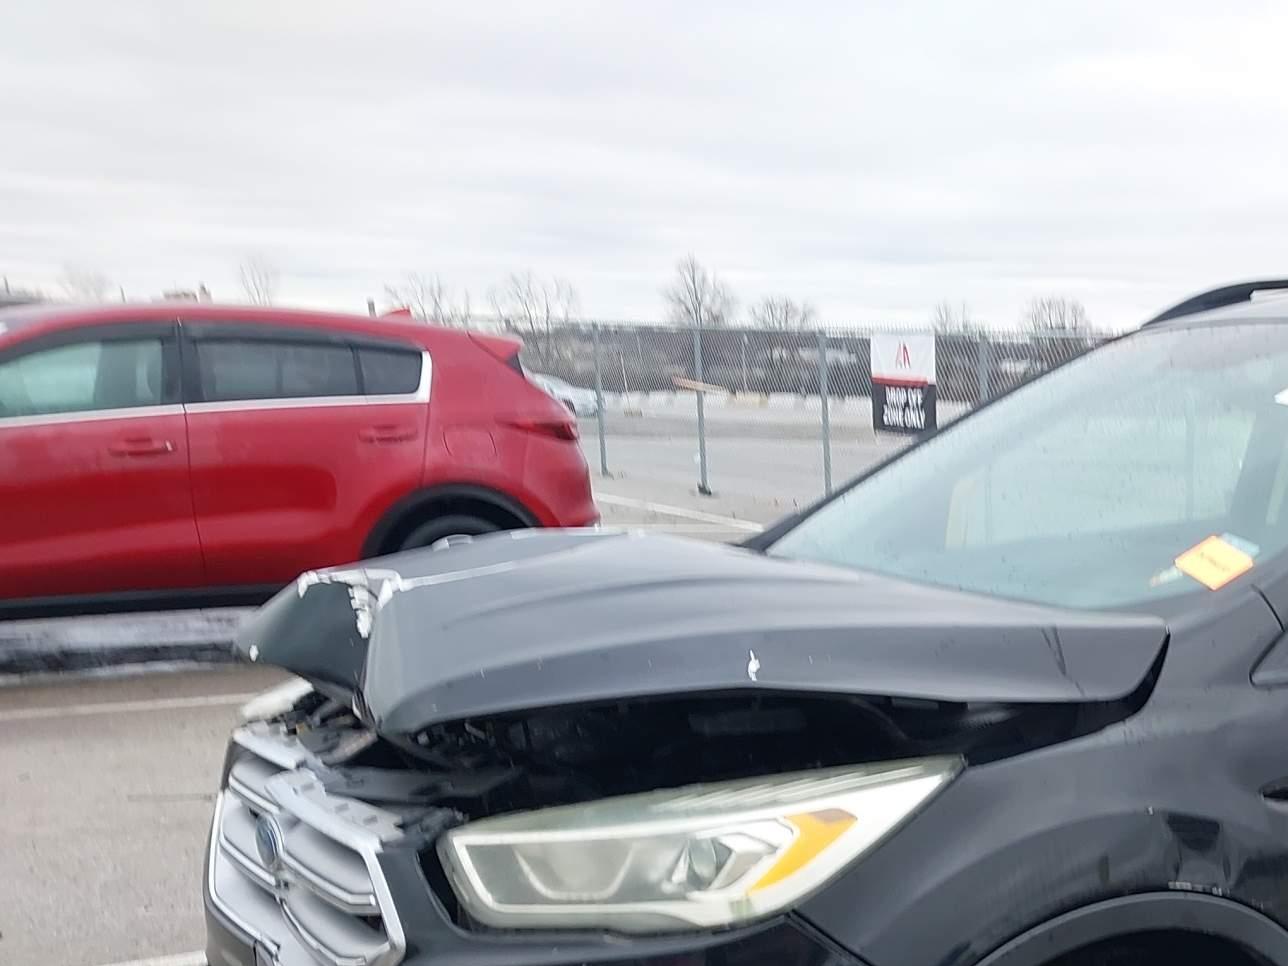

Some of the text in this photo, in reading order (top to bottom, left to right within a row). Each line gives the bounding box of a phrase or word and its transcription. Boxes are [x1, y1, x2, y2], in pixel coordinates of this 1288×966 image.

[885, 386, 923, 407] DROP OFF
[883, 404, 926, 429] ZONE ONLY
